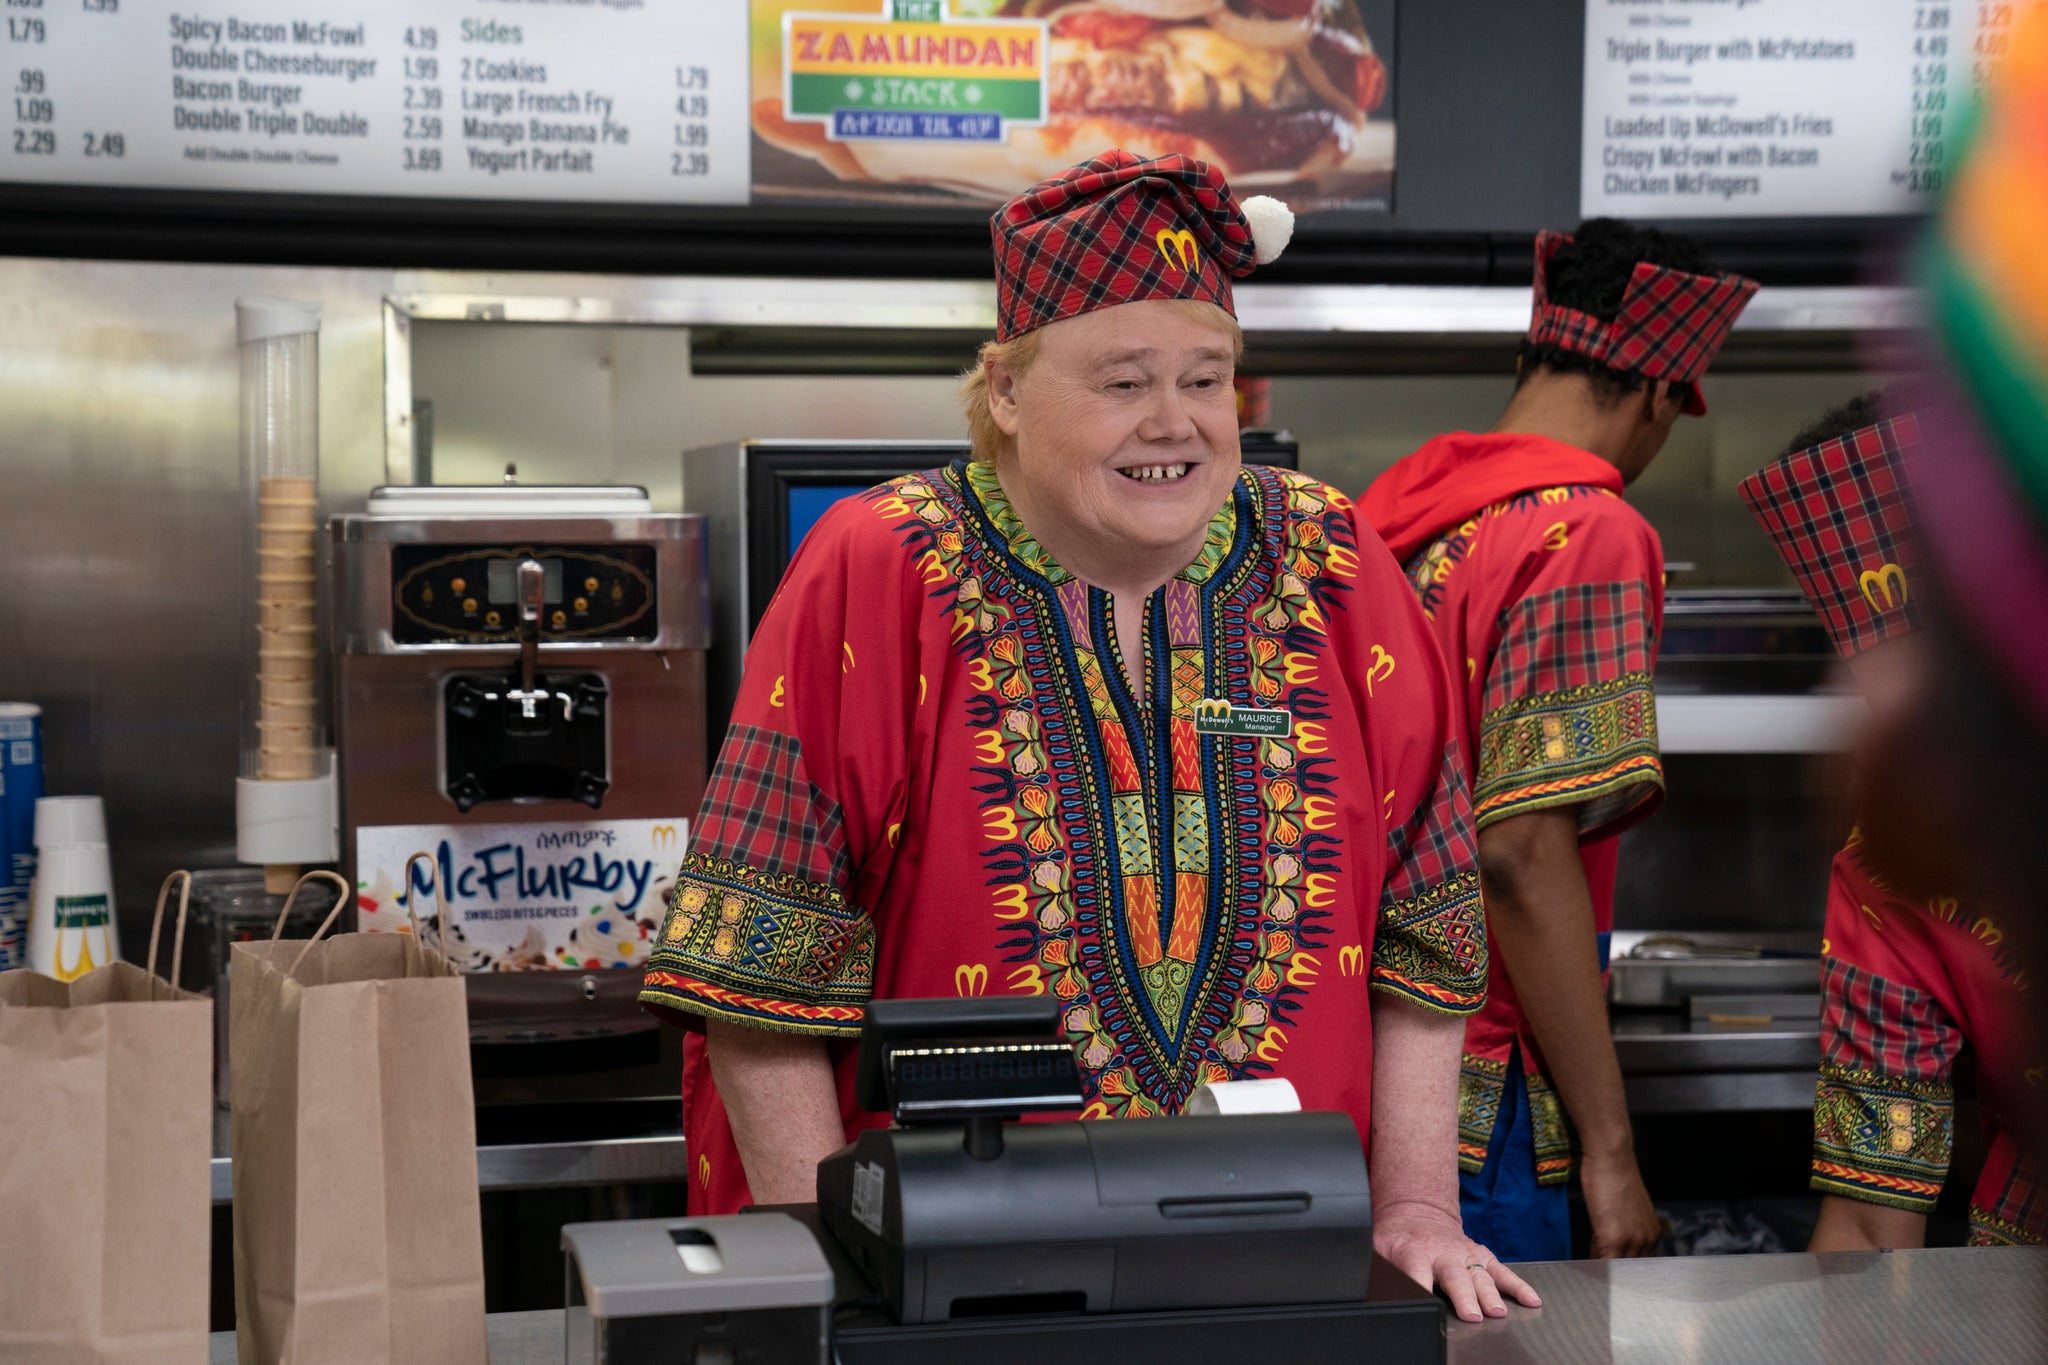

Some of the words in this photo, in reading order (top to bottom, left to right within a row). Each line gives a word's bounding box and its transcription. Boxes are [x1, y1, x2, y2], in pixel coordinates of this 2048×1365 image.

[8, 17, 45, 43] 1.79
[170, 13, 221, 44] Spicy
[228, 17, 287, 43] Bacon
[292, 21, 365, 46] McFowl
[461, 18, 523, 44] Sides
[795, 31, 1036, 68] ZAMUNDAN
[1606, 38, 1650, 66] Triple
[1656, 38, 1711, 65] Burger
[1717, 39, 1752, 61] with
[1758, 39, 1854, 61] McPotatoes
[172, 45, 239, 71] Double
[244, 49, 377, 82] Cheeseburger
[461, 58, 471, 80] 2
[475, 58, 547, 83] Cookies
[15, 69, 46, 94] .99
[173, 76, 232, 101] Bacon
[238, 79, 302, 108] Burger
[872, 78, 957, 106] STACK
[15, 99, 54, 123] 1.09
[462, 88, 513, 115] Large
[518, 90, 580, 114] French
[585, 92, 614, 118] Fry
[174, 105, 240, 131] Double
[247, 109, 297, 138] Triple
[303, 112, 367, 137] Double
[463, 116, 524, 146] Mango
[529, 118, 598, 144] Banana
[601, 120, 630, 145] Pie
[1605, 114, 1665, 138] Loaded
[1670, 115, 1691, 141] Up
[1793, 114, 1833, 137] Fries
[13, 130, 56, 154] 2.29
[83, 132, 126, 158] 2.49
[467, 148, 529, 176] Yogurt
[531, 149, 594, 174] Parfait
[1603, 146, 1654, 170] Crispy
[1660, 147, 1722, 167] McFowl
[1727, 147, 1763, 166] with
[1767, 147, 1819, 168] Bacon
[1603, 173, 1669, 196] Chicken
[1675, 174, 1760, 201] McFingers
[1200, 715, 1234, 725] McDowell's
[1238, 713, 1283, 724] MAURICE
[1245, 723, 1276, 731] Manager
[396, 839, 653, 914] McFlurby
